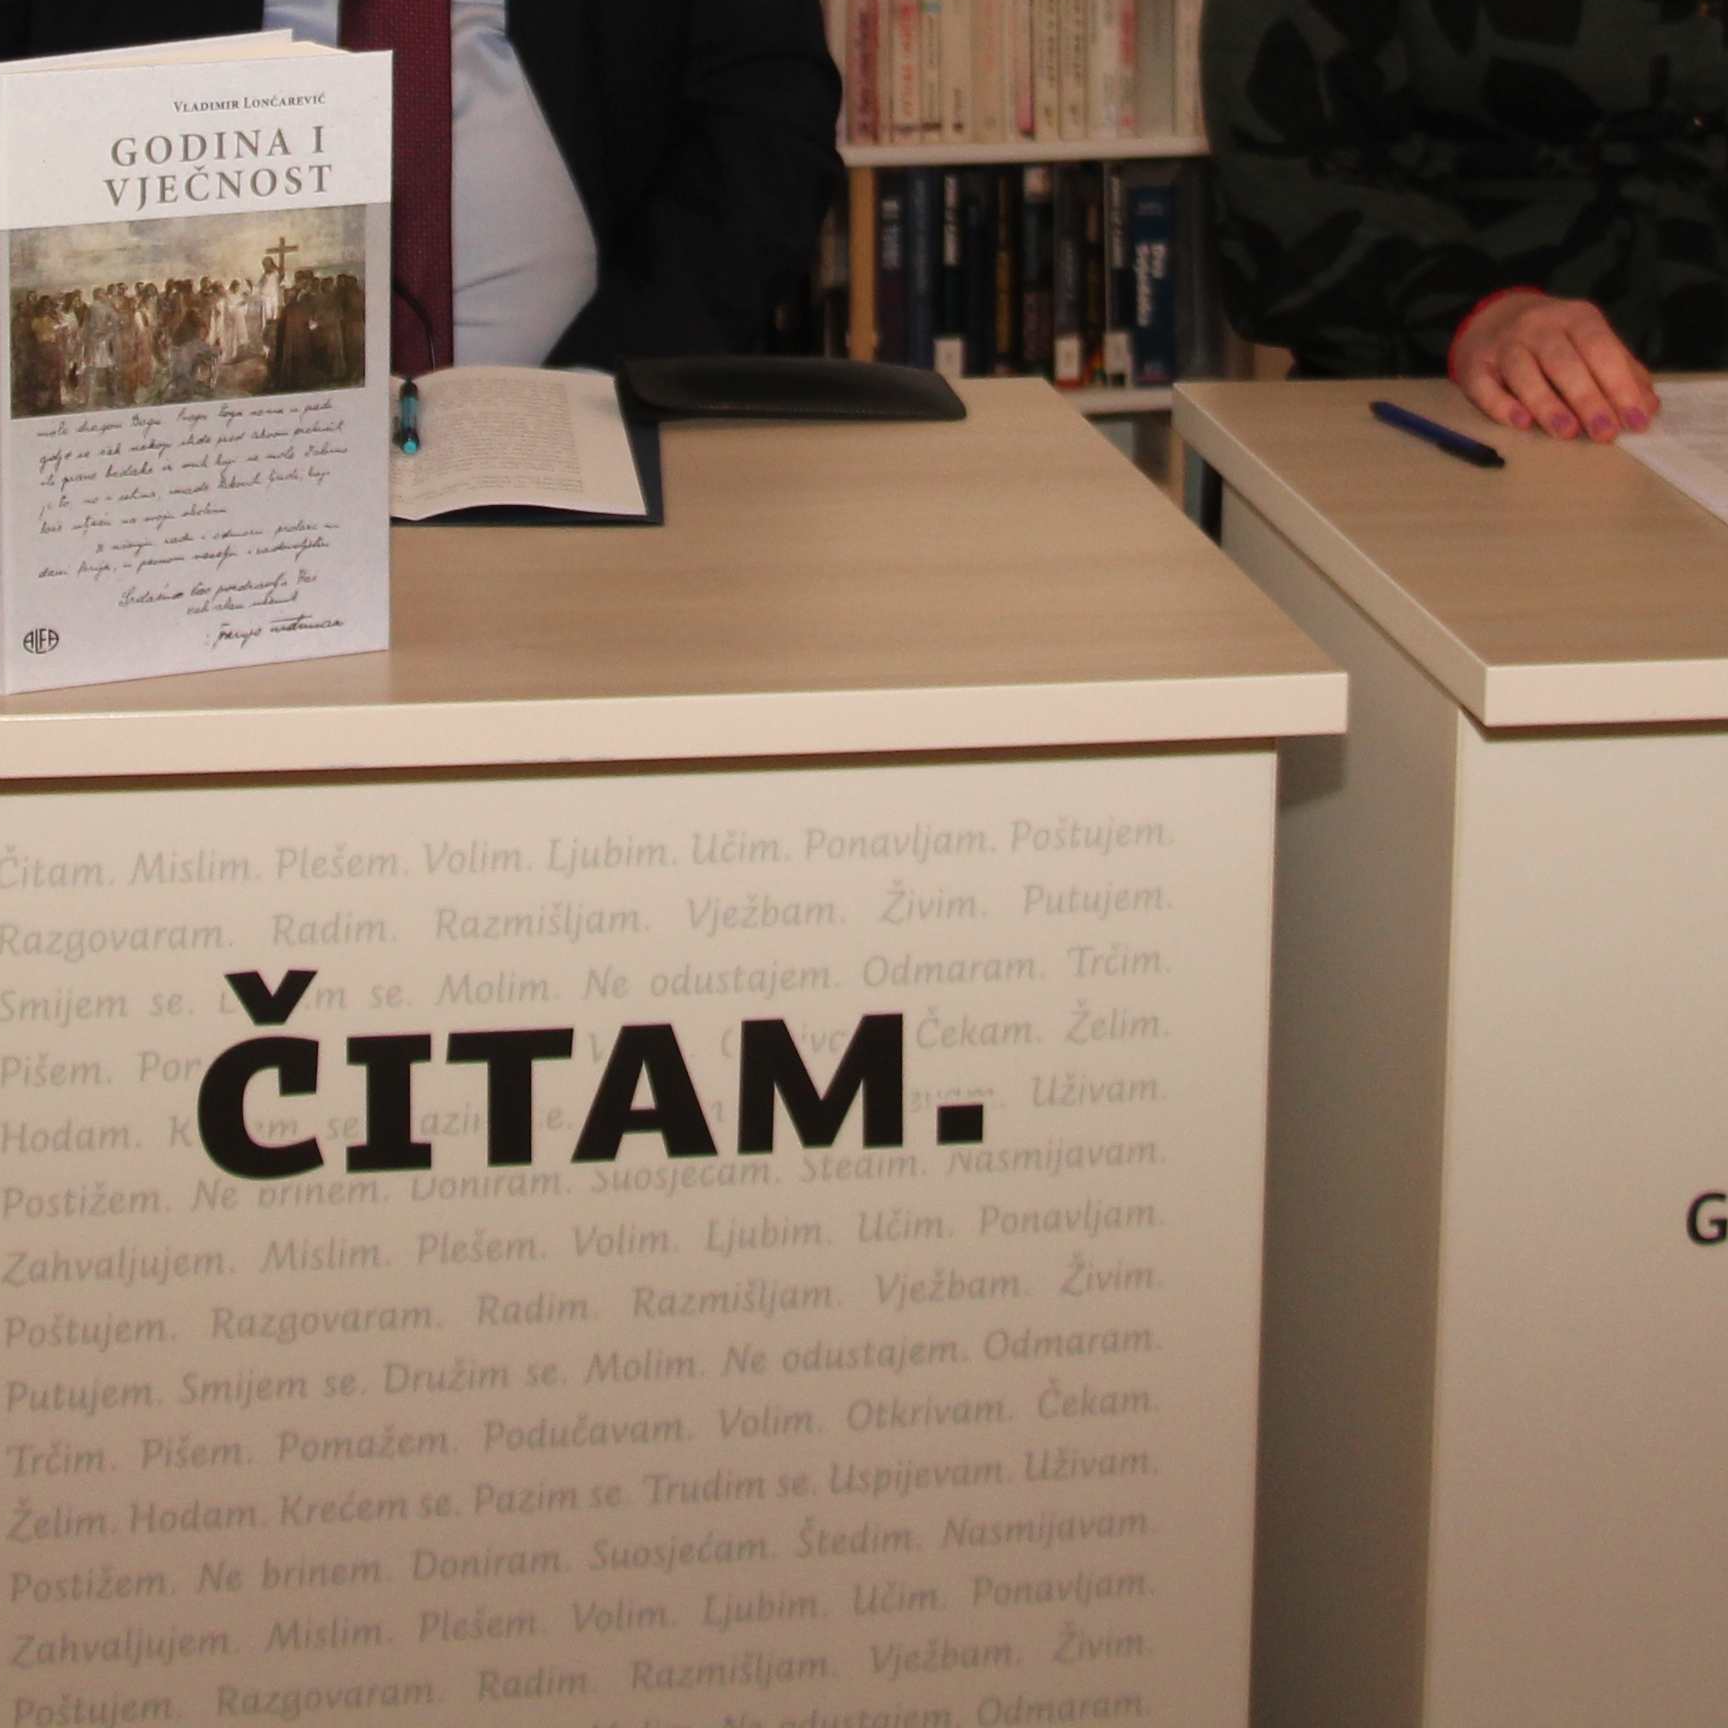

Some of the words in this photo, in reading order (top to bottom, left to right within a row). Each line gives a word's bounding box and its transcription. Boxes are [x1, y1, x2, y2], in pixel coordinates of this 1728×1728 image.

[103, 164, 333, 213] VJEČNOST
[109, 127, 292, 168] GODINA
[311, 125, 325, 154] I
[22, 627, 60, 655] ALFA
[130, 849, 263, 884] Mislim.
[276, 844, 411, 879] Plešem.
[423, 840, 534, 874] Volim.
[547, 835, 679, 876] Ljubim.
[691, 831, 792, 865] Učim.
[805, 823, 999, 863] Ponavljam.
[1011, 818, 1177, 855] Poštujem.
[272, 911, 399, 947] Radim.
[435, 901, 652, 942] Razmišljam.
[687, 894, 848, 938] Vježbam.
[880, 879, 989, 925] Živim.
[1023, 881, 1175, 919] Putujem.
[151, 991, 196, 1017] se.
[370, 983, 415, 1009] se.
[437, 971, 562, 1005] Molim.
[584, 966, 628, 999] Ne
[649, 963, 843, 1000] odustajem.
[861, 953, 1048, 989] Odmaram.
[1067, 944, 1174, 978] Trčim.
[0, 1051, 115, 1088] Pišem.
[915, 1007, 1041, 1050] Čekam.
[1064, 998, 1173, 1046] Želim.
[196, 968, 985, 1181] ČITAM.
[0, 1117, 143, 1155] Hodam.
[1031, 1071, 1171, 1108] Uživam.
[1, 1180, 173, 1219] Postižem.
[191, 1176, 238, 1212] Ne
[0, 1245, 237, 1289] Zahvaljujem.
[261, 1236, 393, 1273] Mislim.
[416, 1228, 550, 1265] Plešem.
[572, 1222, 683, 1258] Volim.
[705, 1214, 835, 1258] Ljubim.
[857, 1206, 957, 1244] Učim.
[979, 1198, 1169, 1238] Ponavljam.
[4, 1311, 179, 1354] Poštujem.
[210, 1304, 446, 1346] Razgovaram.
[476, 1290, 602, 1327] Radim.
[632, 1277, 845, 1320] Razmišljam.
[875, 1267, 1033, 1312] Vježbam.
[1058, 1251, 1167, 1298] Živim.
[5, 1377, 166, 1418] Putujem.
[179, 1369, 309, 1411] Smijem
[323, 1371, 369, 1399] se.
[383, 1355, 511, 1396] Družim
[526, 1360, 571, 1388] se.
[583, 1347, 709, 1384] Molim.
[722, 1342, 768, 1376] Ne
[780, 1338, 972, 1374] odustajem.
[982, 1325, 1166, 1362] Odmaram.
[4, 1439, 118, 1479] Trčim.
[140, 1432, 256, 1470] Pišem.
[277, 1422, 462, 1463] Pomažem.
[483, 1412, 697, 1452] Podučavam.
[717, 1403, 827, 1440] Volim.
[845, 1396, 1018, 1433] Otkrivam.
[1036, 1375, 1165, 1421] Čekam.
[5, 1495, 120, 1545] Želim.
[128, 1497, 270, 1535] Hodam.
[279, 1489, 409, 1527] Krećem
[418, 1491, 465, 1520] se.
[473, 1480, 580, 1515] Pazim
[589, 1482, 635, 1510] se.
[641, 1468, 767, 1507] Trudim
[777, 1471, 822, 1499] se.
[828, 1459, 1016, 1499] Uspijevam.
[1023, 1445, 1163, 1484] Uživam.
[9, 1563, 179, 1604] Postižem.
[196, 1558, 244, 1594] Ne
[260, 1556, 395, 1591] brinem.
[411, 1546, 574, 1582] Doniram.
[589, 1530, 781, 1574] Suosjećam.
[795, 1514, 925, 1560] Štedim.
[941, 1510, 1161, 1550] Nasmijavam.
[7, 1626, 243, 1671] Zahvaljujem.
[264, 1615, 396, 1653] Mislim.
[417, 1605, 550, 1643] Plešem.
[571, 1597, 681, 1634] Volim.
[702, 1589, 832, 1633] Ljubim.
[851, 1579, 952, 1617] Učim.
[971, 1569, 1159, 1608] Ponavljam.
[215, 1679, 447, 1723] Razgovaram.
[476, 1664, 601, 1702] Radim.
[629, 1649, 842, 1692] Razmišljam.
[869, 1636, 1026, 1682] Vježbam.
[1051, 1619, 1158, 1666] Živim.
